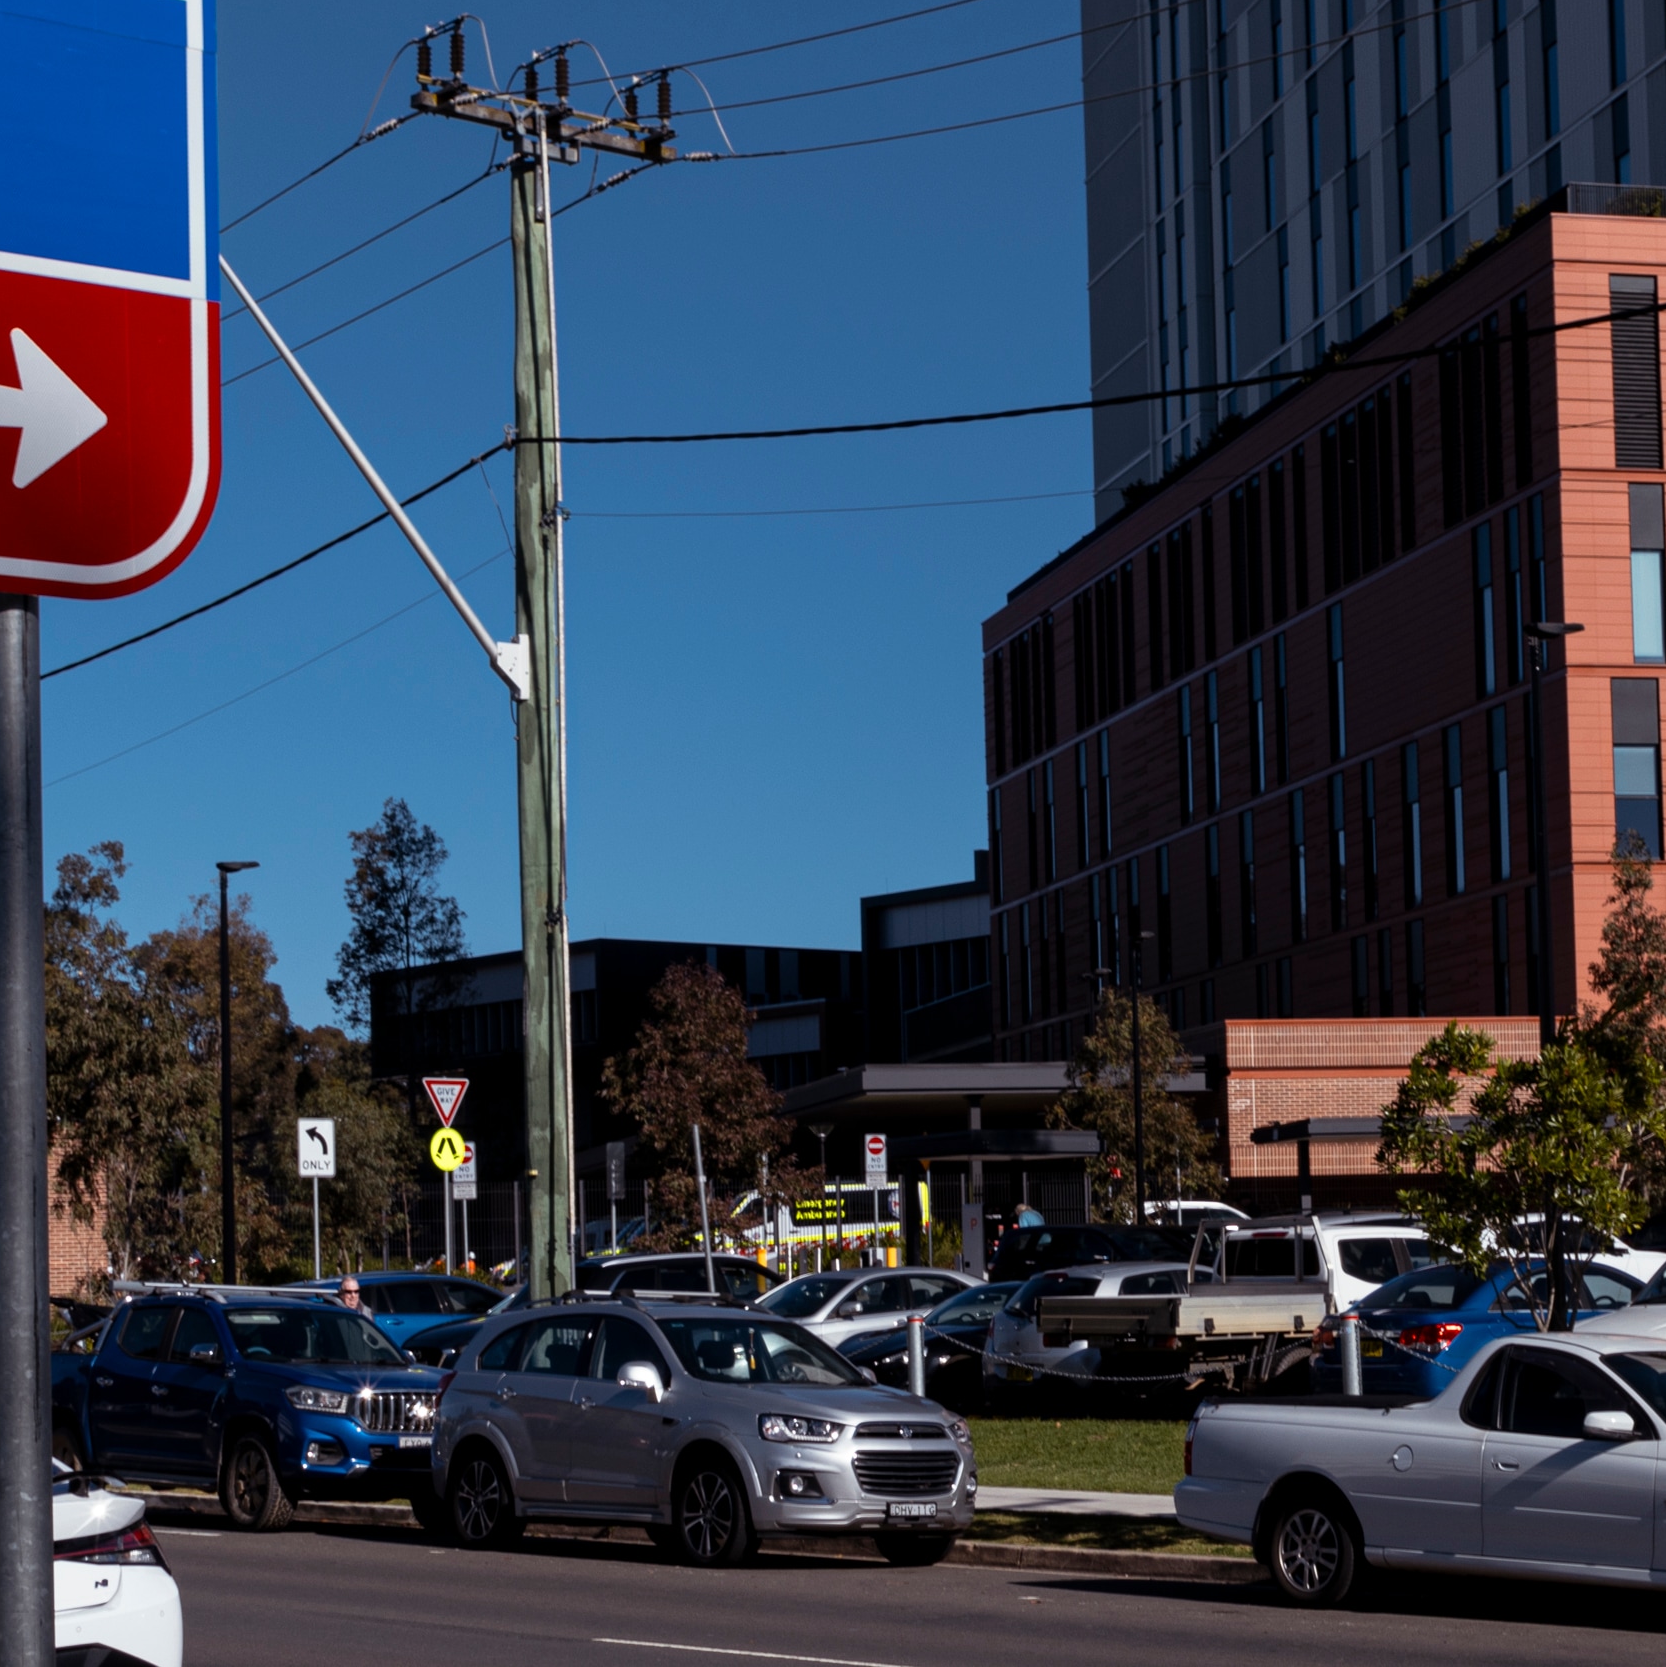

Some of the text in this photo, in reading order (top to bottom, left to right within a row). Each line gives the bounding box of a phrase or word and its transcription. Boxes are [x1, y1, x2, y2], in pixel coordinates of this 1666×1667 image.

[437, 1087, 456, 1096] GIVE
[302, 1160, 331, 1170] ONLY
[796, 1210, 846, 1220] Ambuane
